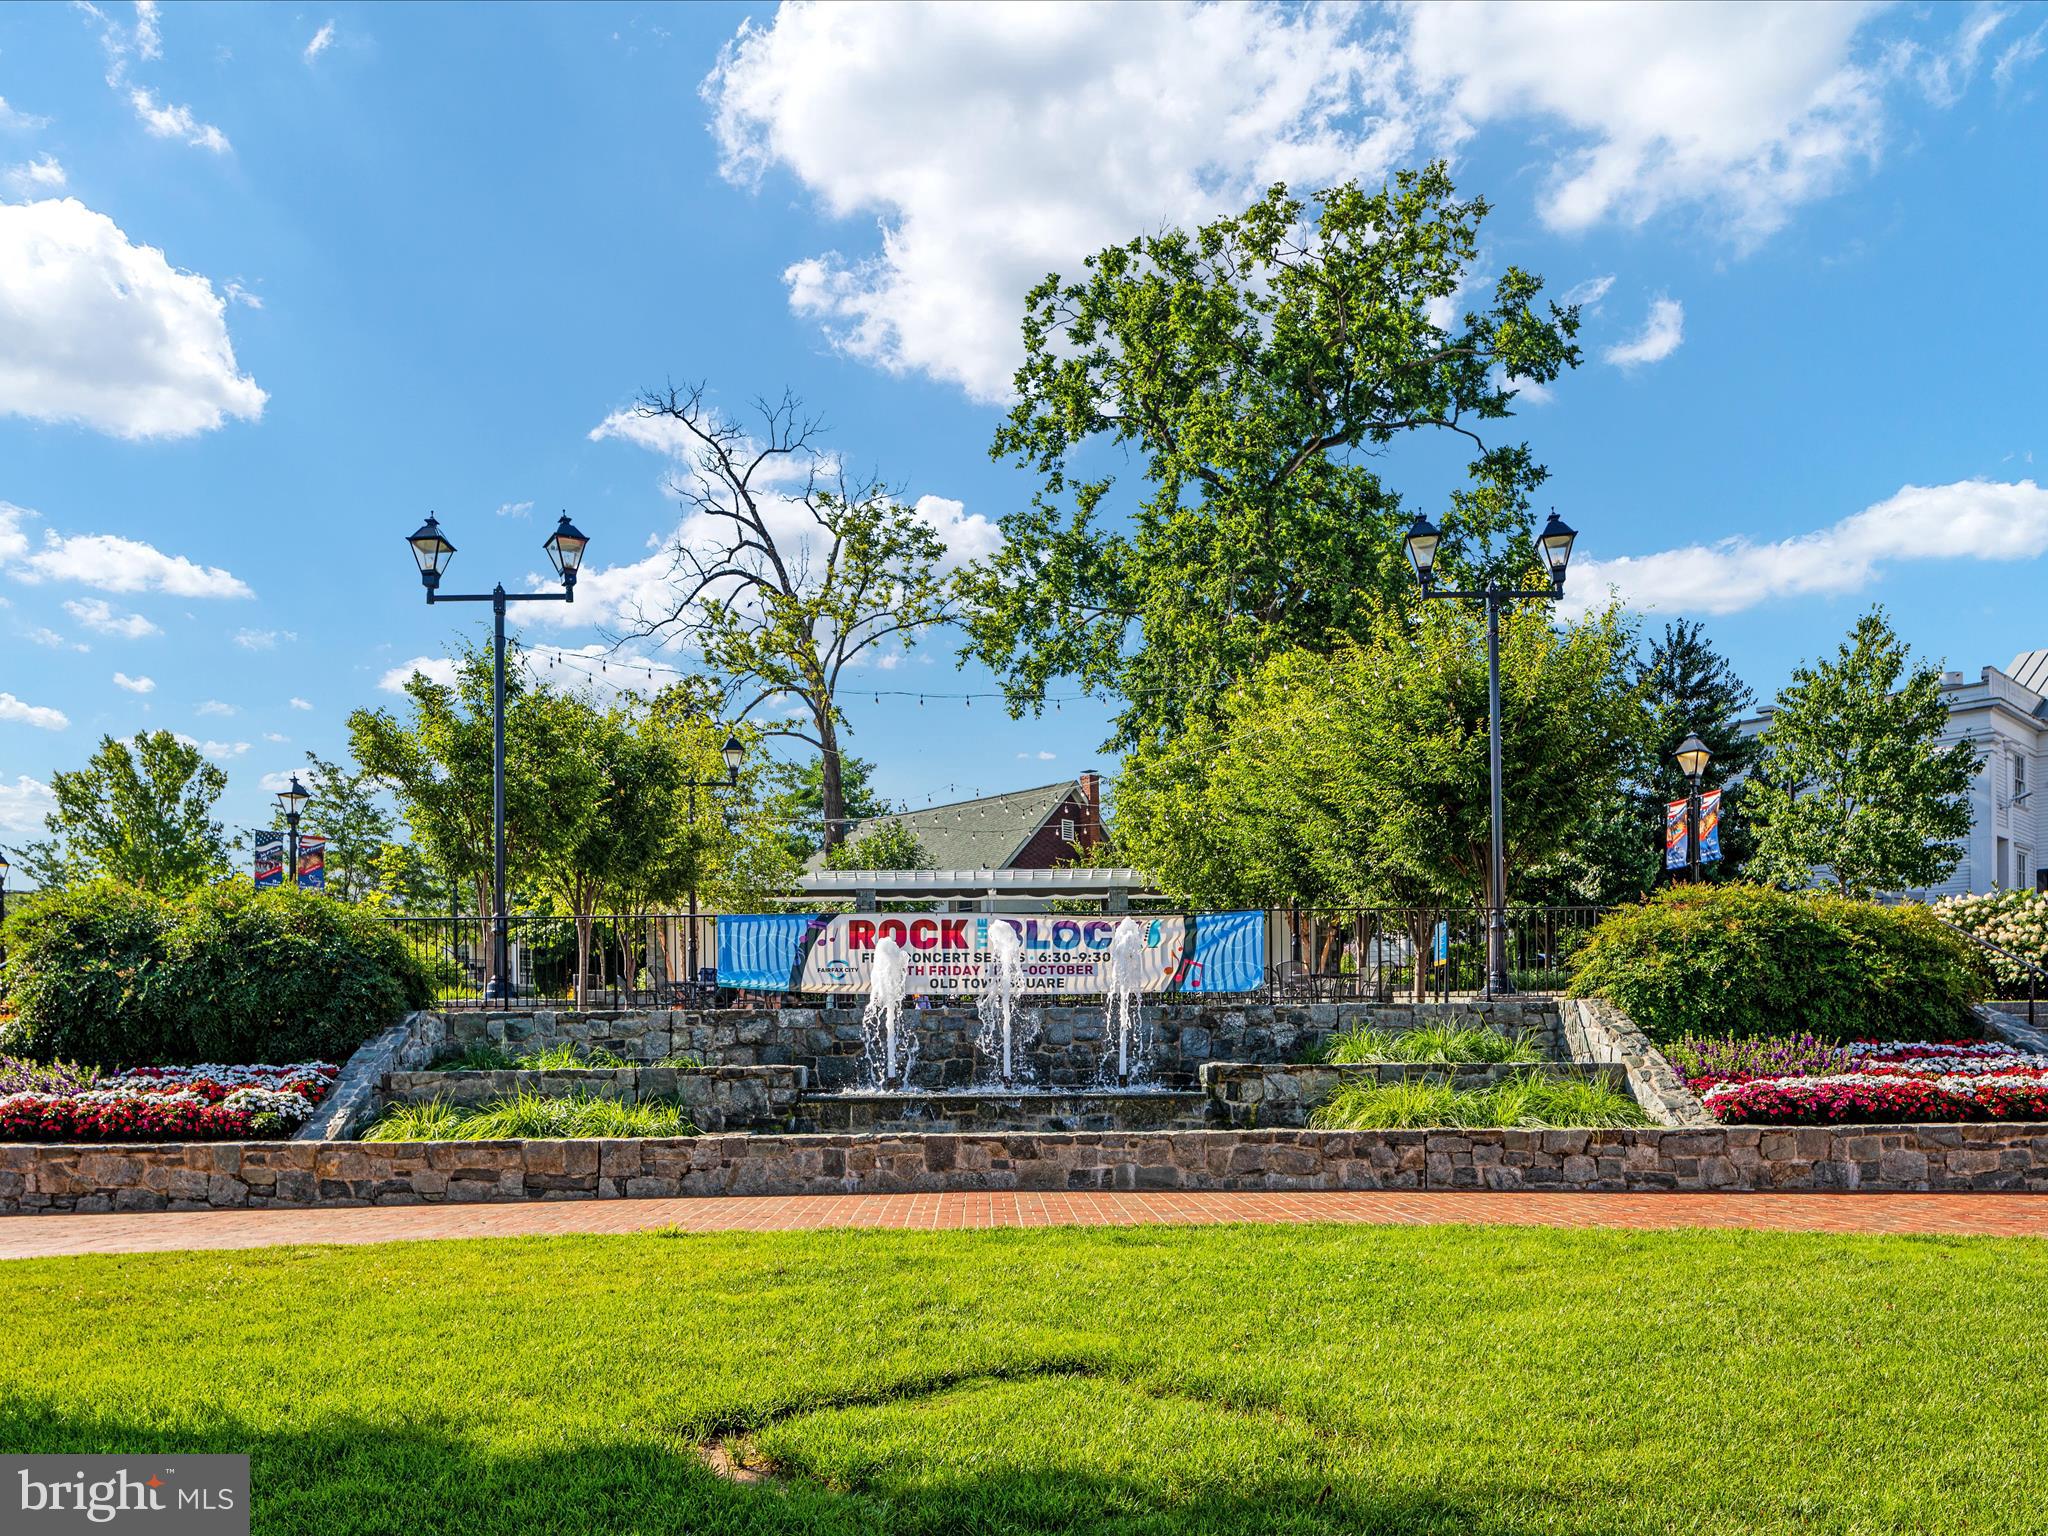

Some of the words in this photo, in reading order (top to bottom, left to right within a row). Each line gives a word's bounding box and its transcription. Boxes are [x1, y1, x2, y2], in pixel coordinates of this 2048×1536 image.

[848, 918, 969, 950] ROCK
[976, 918, 988, 950] THE
[995, 918, 1142, 950] LOC
[1038, 952, 1111, 963] 6:30-9:30
[929, 965, 980, 976] FRIDAY
[930, 978, 958, 989] OLD
